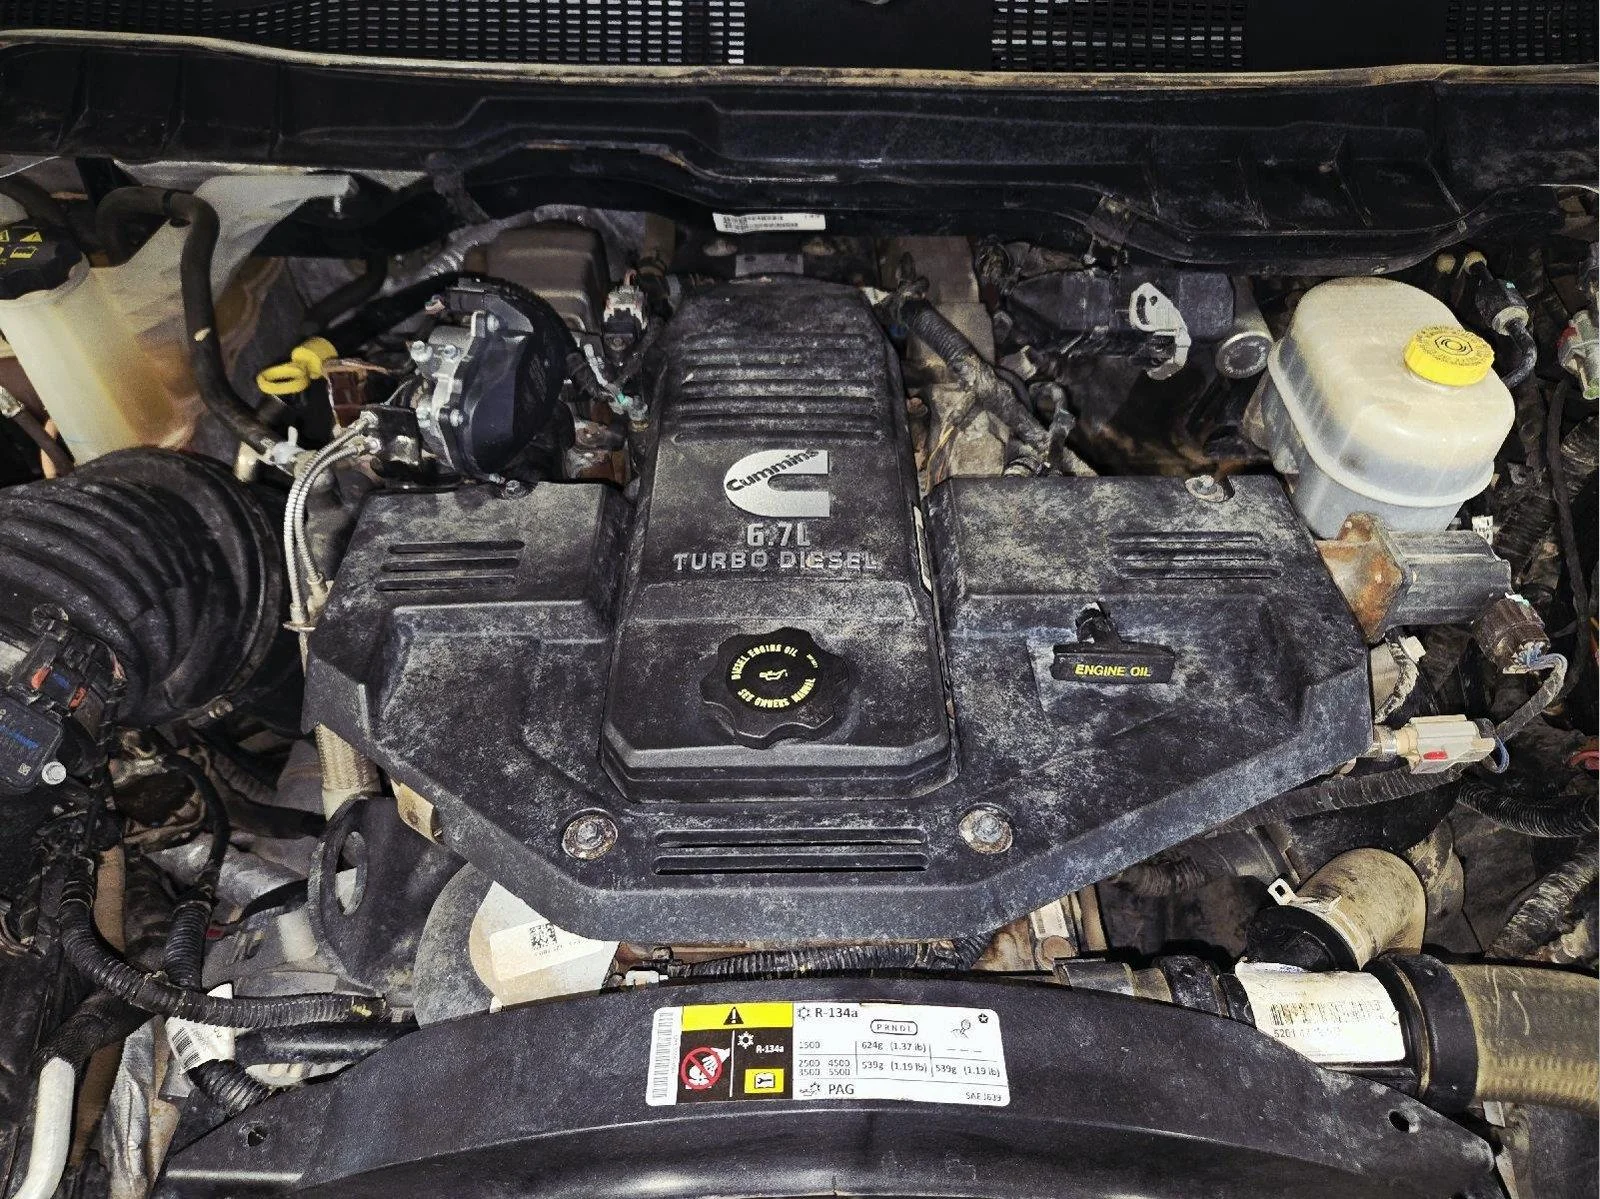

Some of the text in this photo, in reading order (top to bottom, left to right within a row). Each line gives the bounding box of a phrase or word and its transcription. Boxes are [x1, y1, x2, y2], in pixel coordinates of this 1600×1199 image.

[725, 448, 820, 491] Cummins
[747, 521, 811, 547] 6.7L
[672, 551, 880, 571] TURBO DIESEL
[784, 646, 799, 657] OIL
[1074, 663, 1152, 677] ENGINE OIL
[815, 1007, 858, 1018] R-134a
[755, 1044, 784, 1054] R-134a
[799, 1041, 821, 1049] 1500
[861, 1041, 884, 1051] 624g
[798, 1059, 851, 1067] 2500 4500
[862, 1061, 884, 1071] 539g
[828, 1068, 851, 1076] 5500
[935, 1064, 957, 1075] 539g
[828, 1083, 855, 1095] PAG
